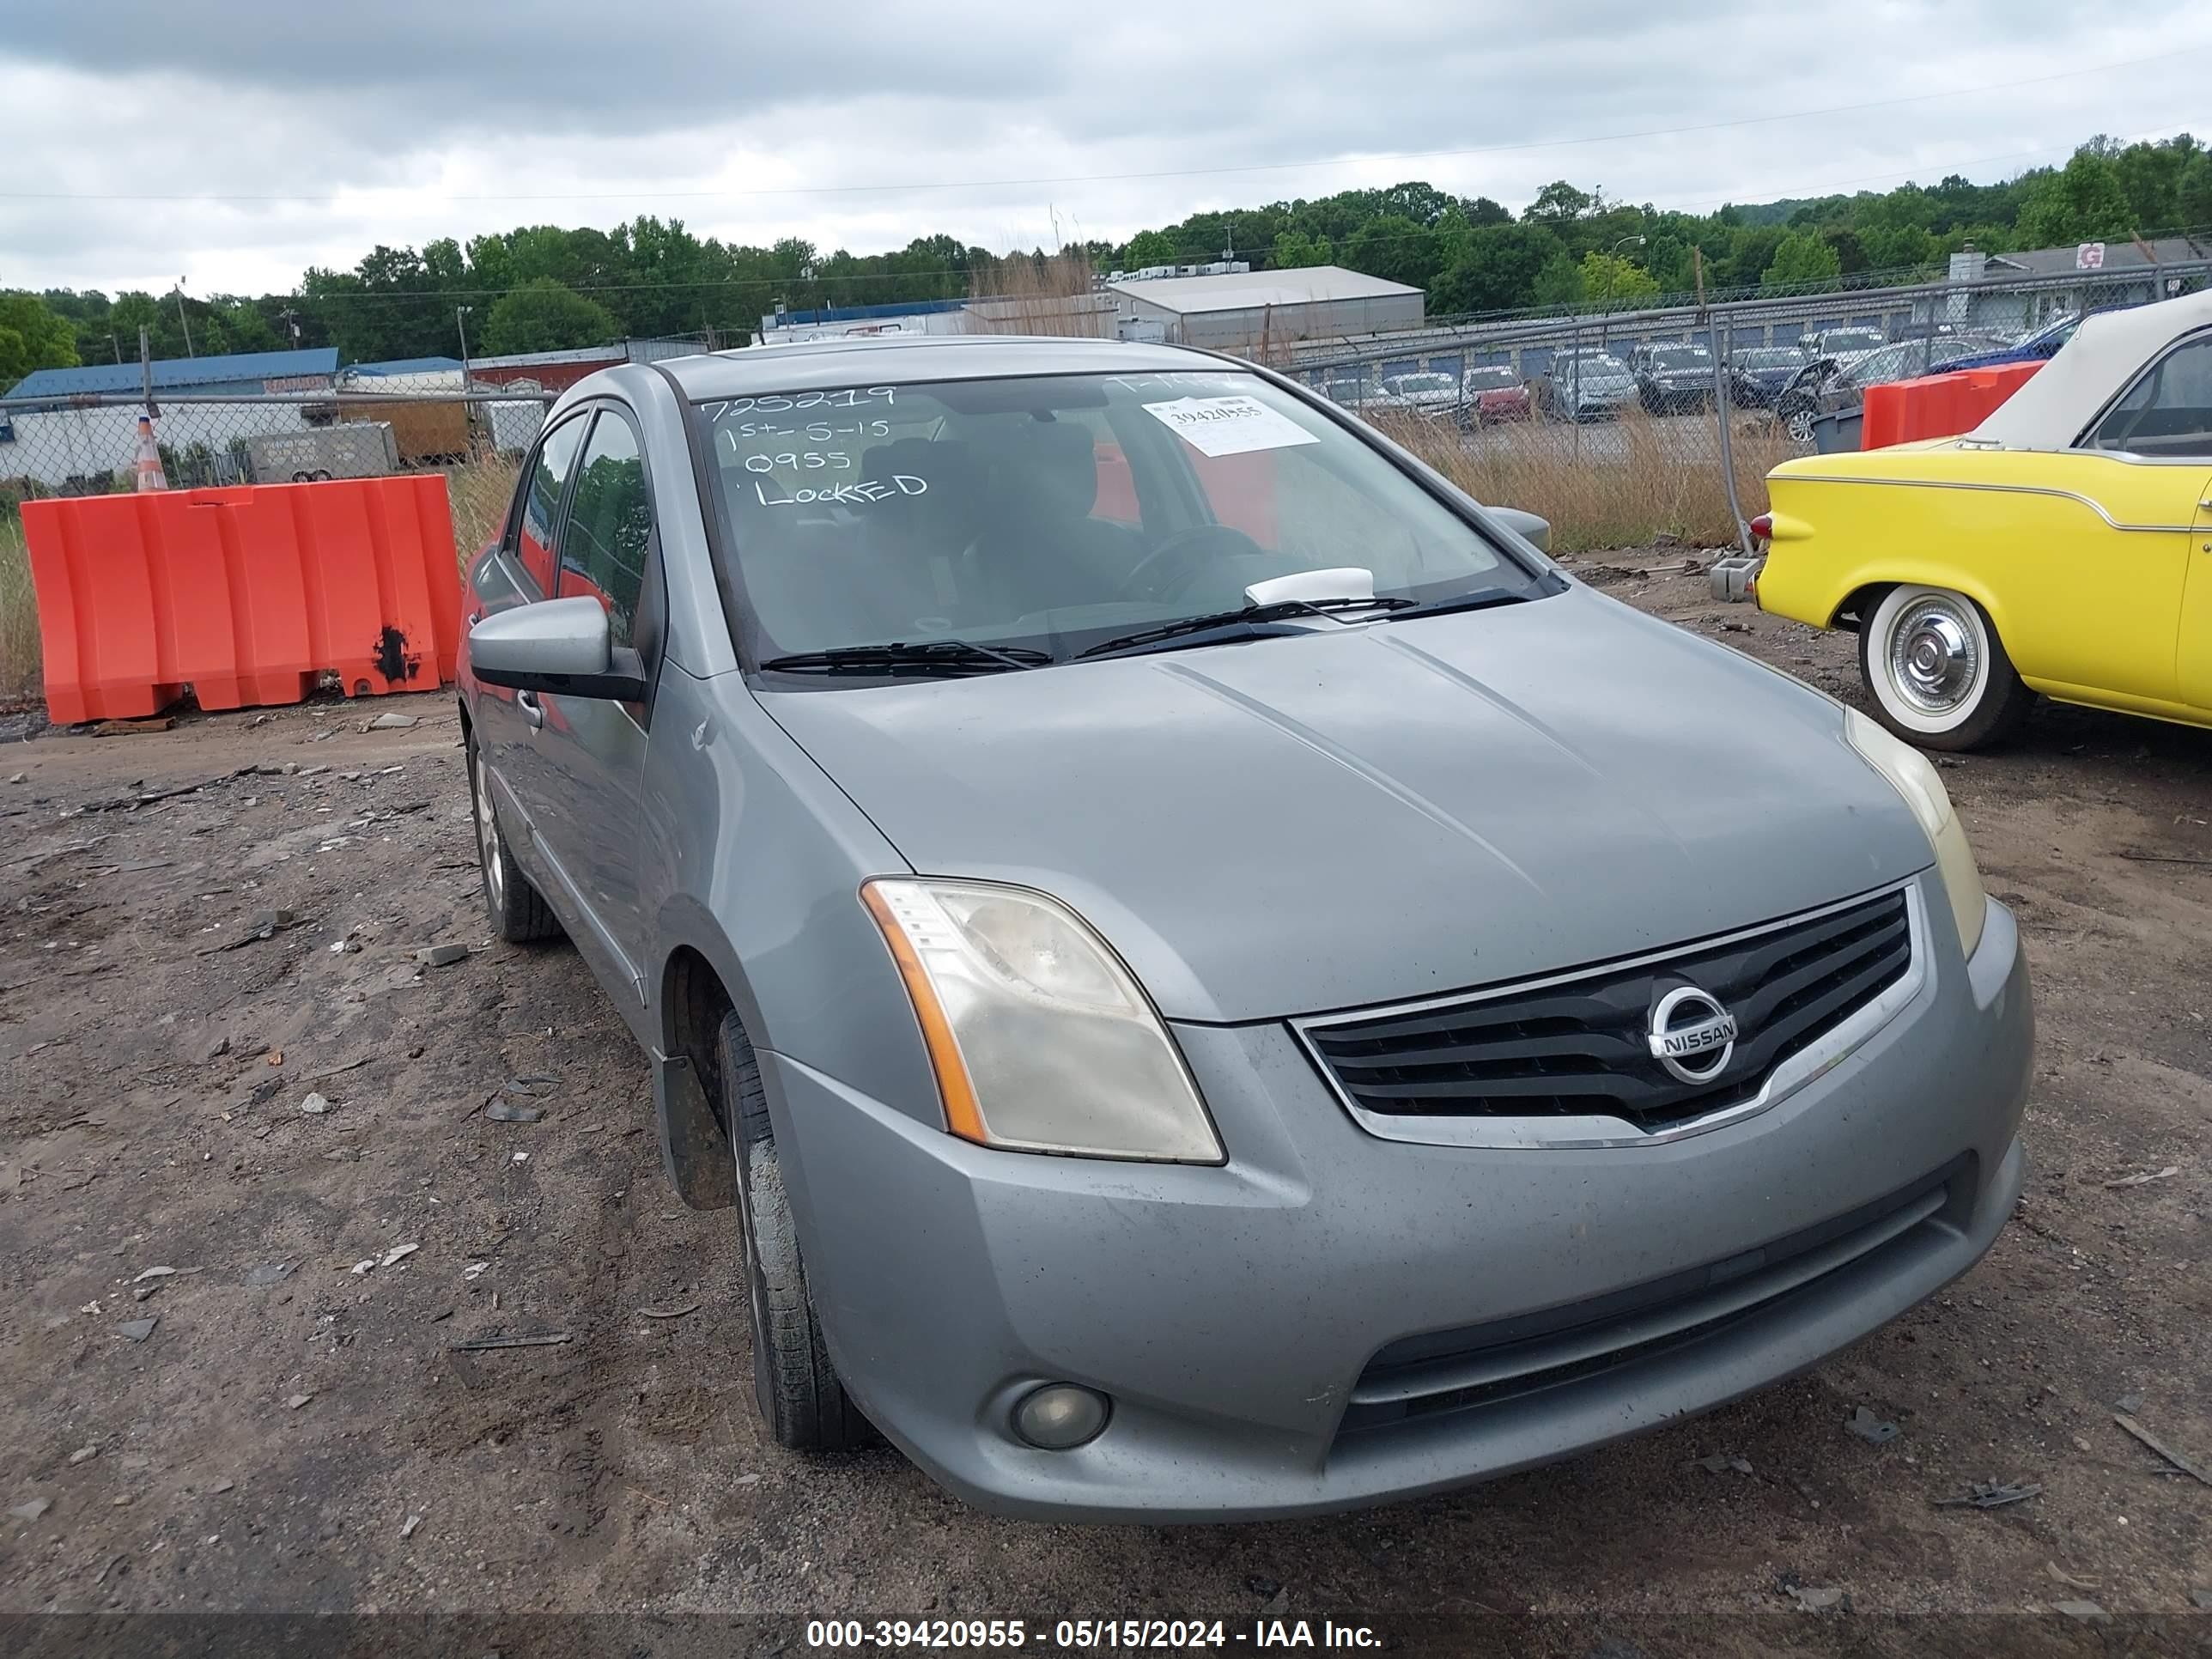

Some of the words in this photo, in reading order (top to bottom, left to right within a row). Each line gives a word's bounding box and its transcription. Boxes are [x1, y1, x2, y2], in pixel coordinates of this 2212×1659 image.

[700, 386, 897, 422] 725219
[744, 452, 852, 473] 0955
[1664, 1021, 1734, 1054] NISSAN
